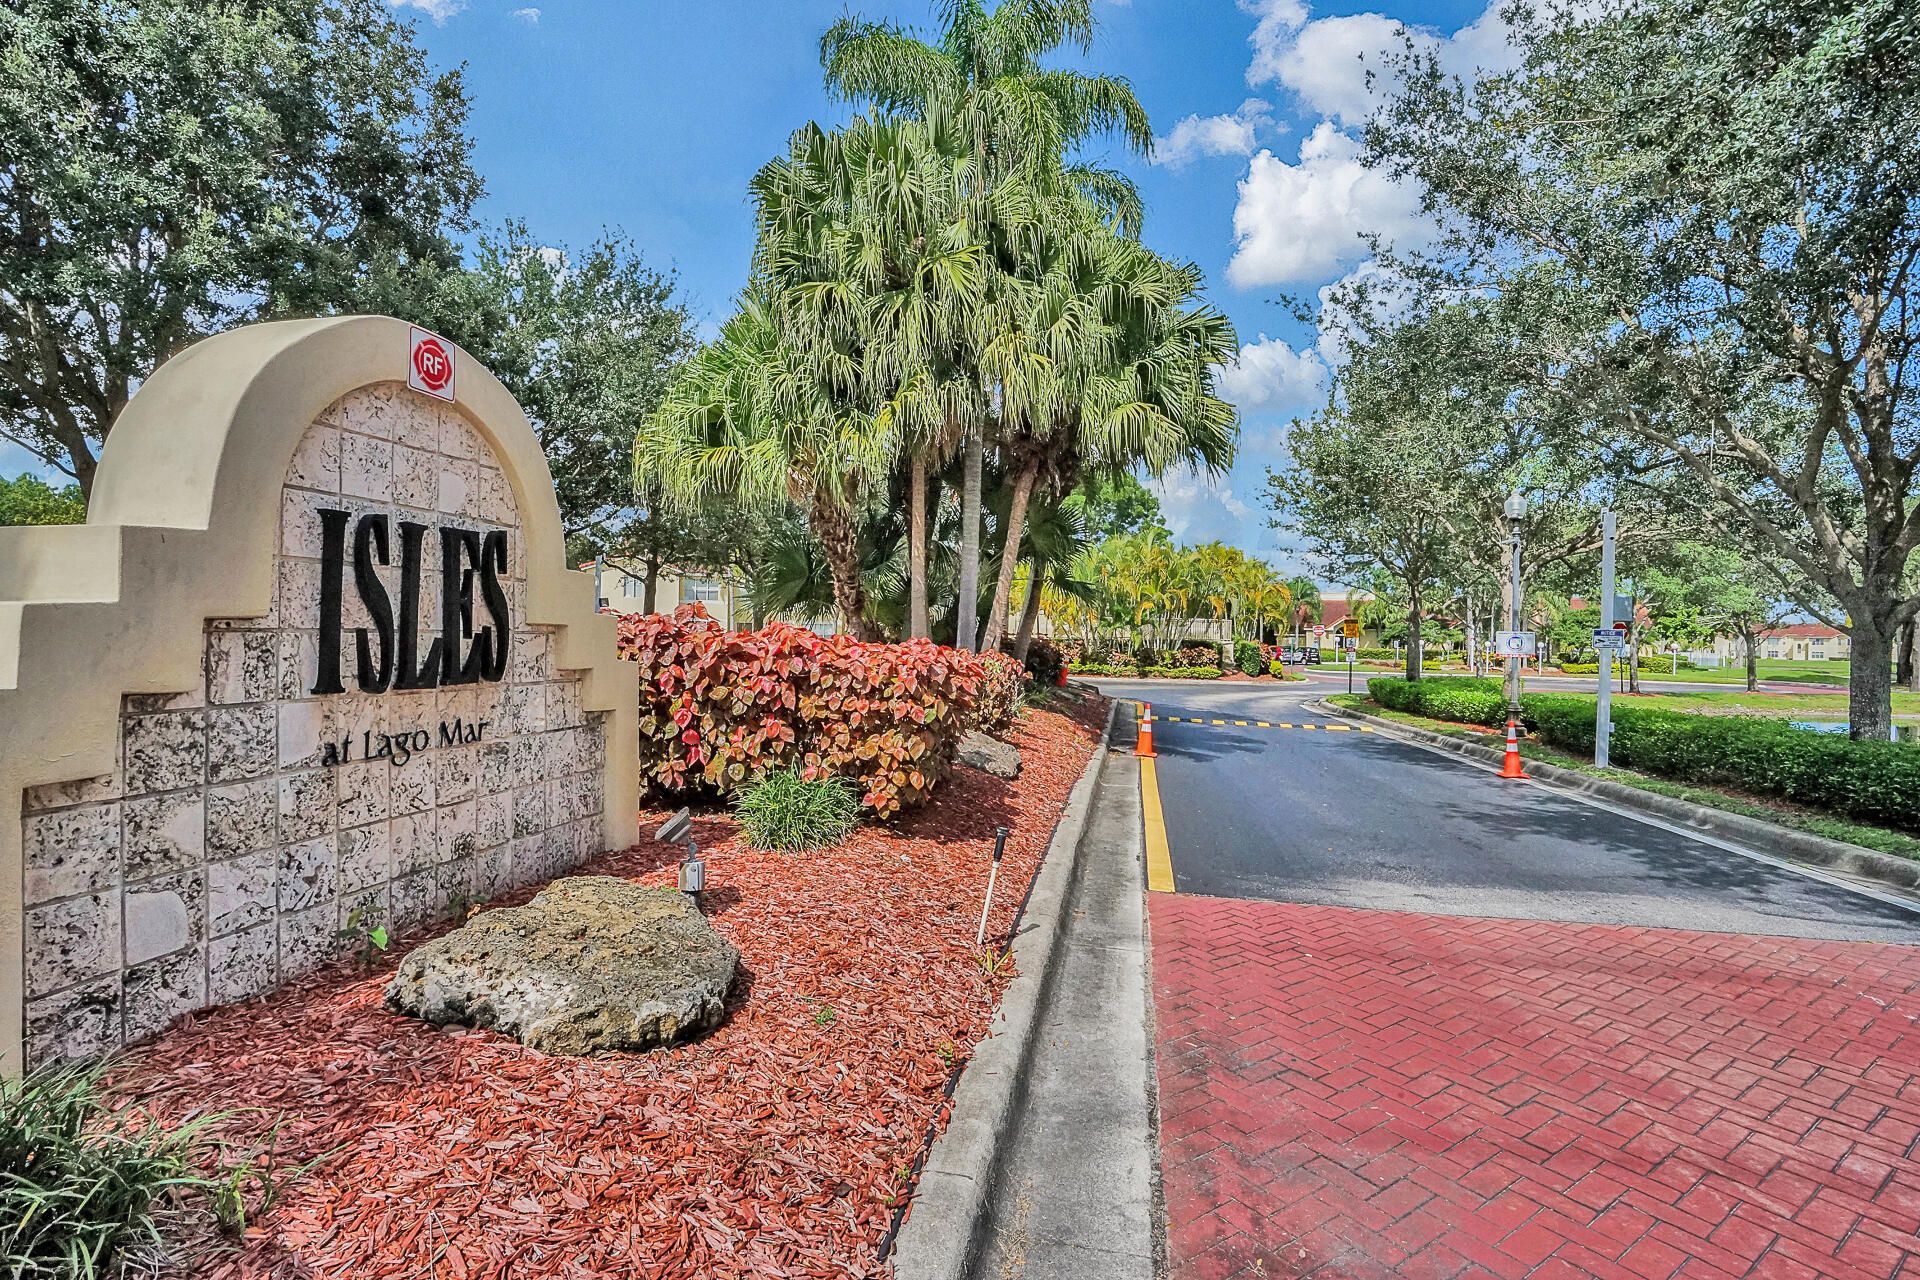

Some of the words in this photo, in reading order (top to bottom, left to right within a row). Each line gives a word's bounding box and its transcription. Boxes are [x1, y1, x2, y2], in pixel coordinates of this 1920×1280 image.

[423, 352, 443, 375] RF
[310, 507, 510, 695] ISLES
[321, 731, 353, 767] at
[363, 729, 430, 767] Lago
[438, 717, 490, 749] Mar
